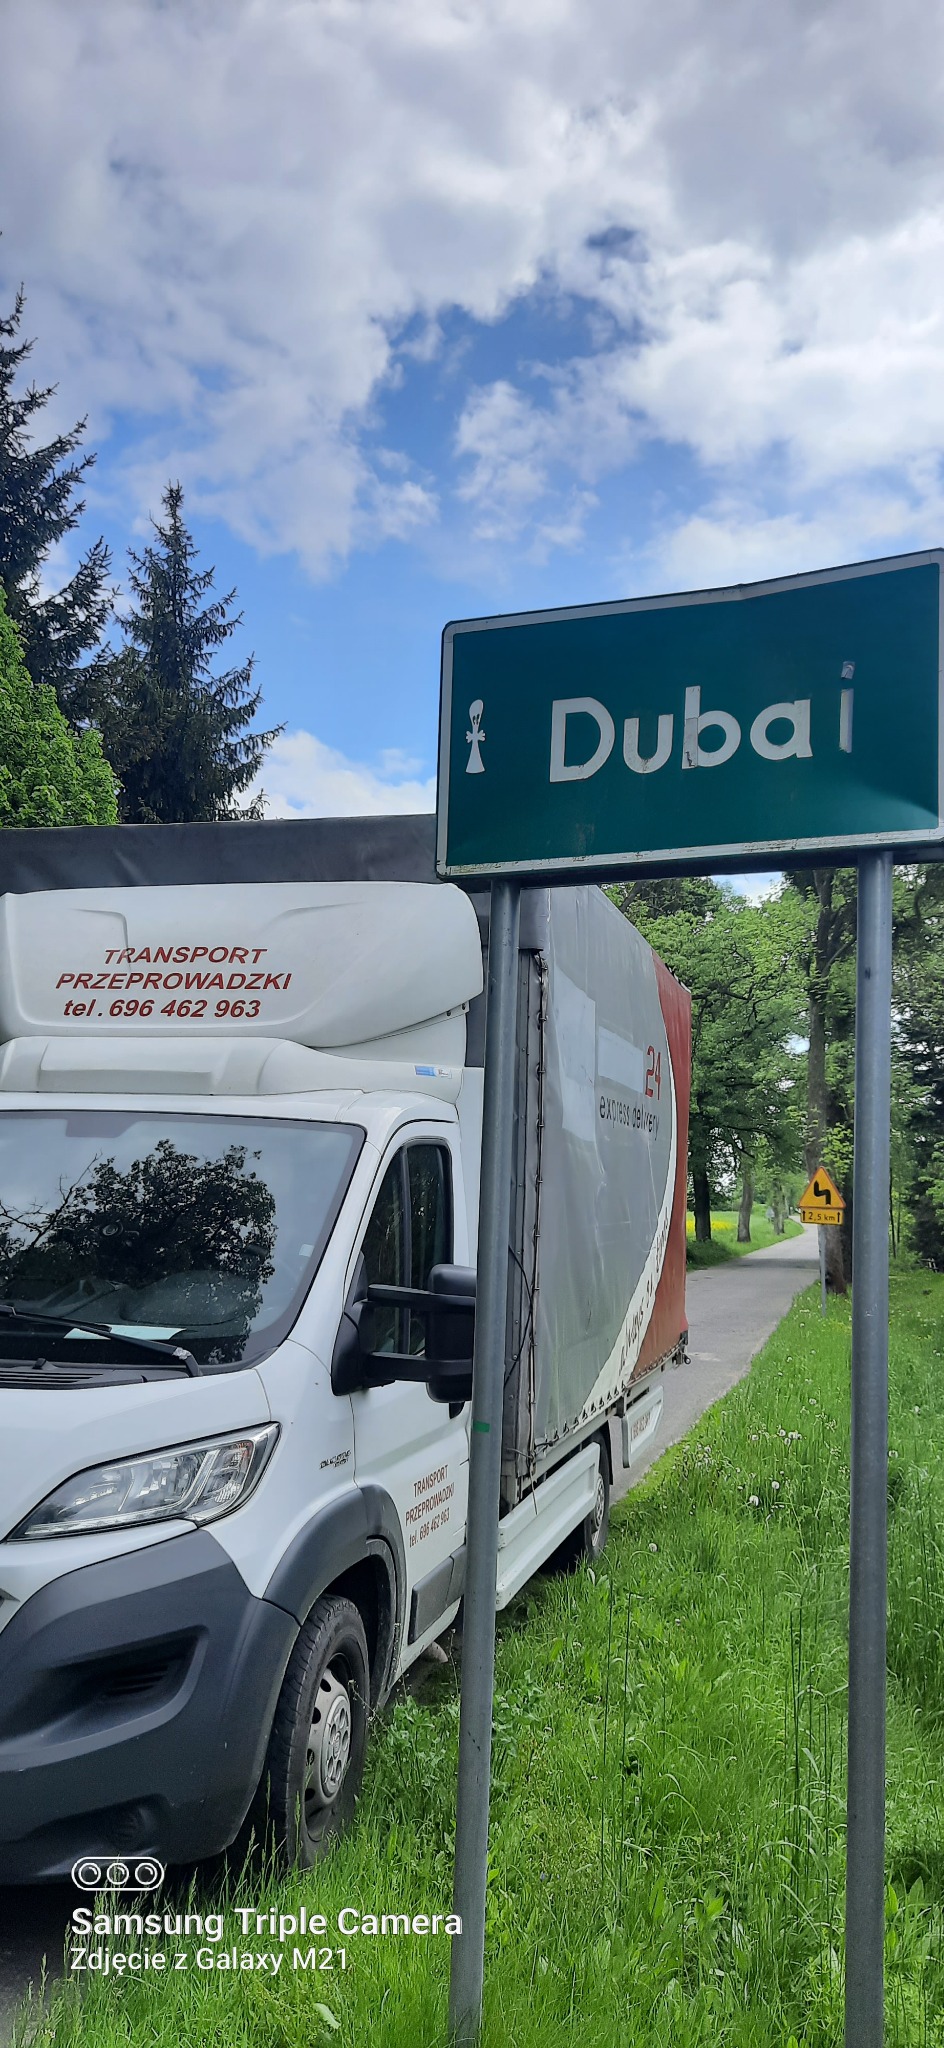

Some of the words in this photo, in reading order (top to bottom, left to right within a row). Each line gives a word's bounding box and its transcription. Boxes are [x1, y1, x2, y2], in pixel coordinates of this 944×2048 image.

[549, 661, 855, 782] Dubai
[104, 946, 267, 965] TRANSPORT
[55, 972, 292, 990] PRZEPROWADZKI
[63, 999, 103, 1017] tel.
[109, 999, 154, 1017] 696
[160, 999, 206, 1017] 462
[213, 999, 260, 1018] 963
[645, 1045, 661, 1100] 24
[600, 1095, 630, 1128] express
[632, 1106, 660, 1141] delivery
[808, 1211, 822, 1221] 2,5
[414, 1465, 448, 1497] TRANSPORT
[405, 1482, 454, 1526] PRZEPROWADZKI
[409, 1531, 419, 1548] tel.
[419, 1524, 430, 1541] 696
[430, 1517, 440, 1533] 462
[440, 1507, 450, 1526] 963
